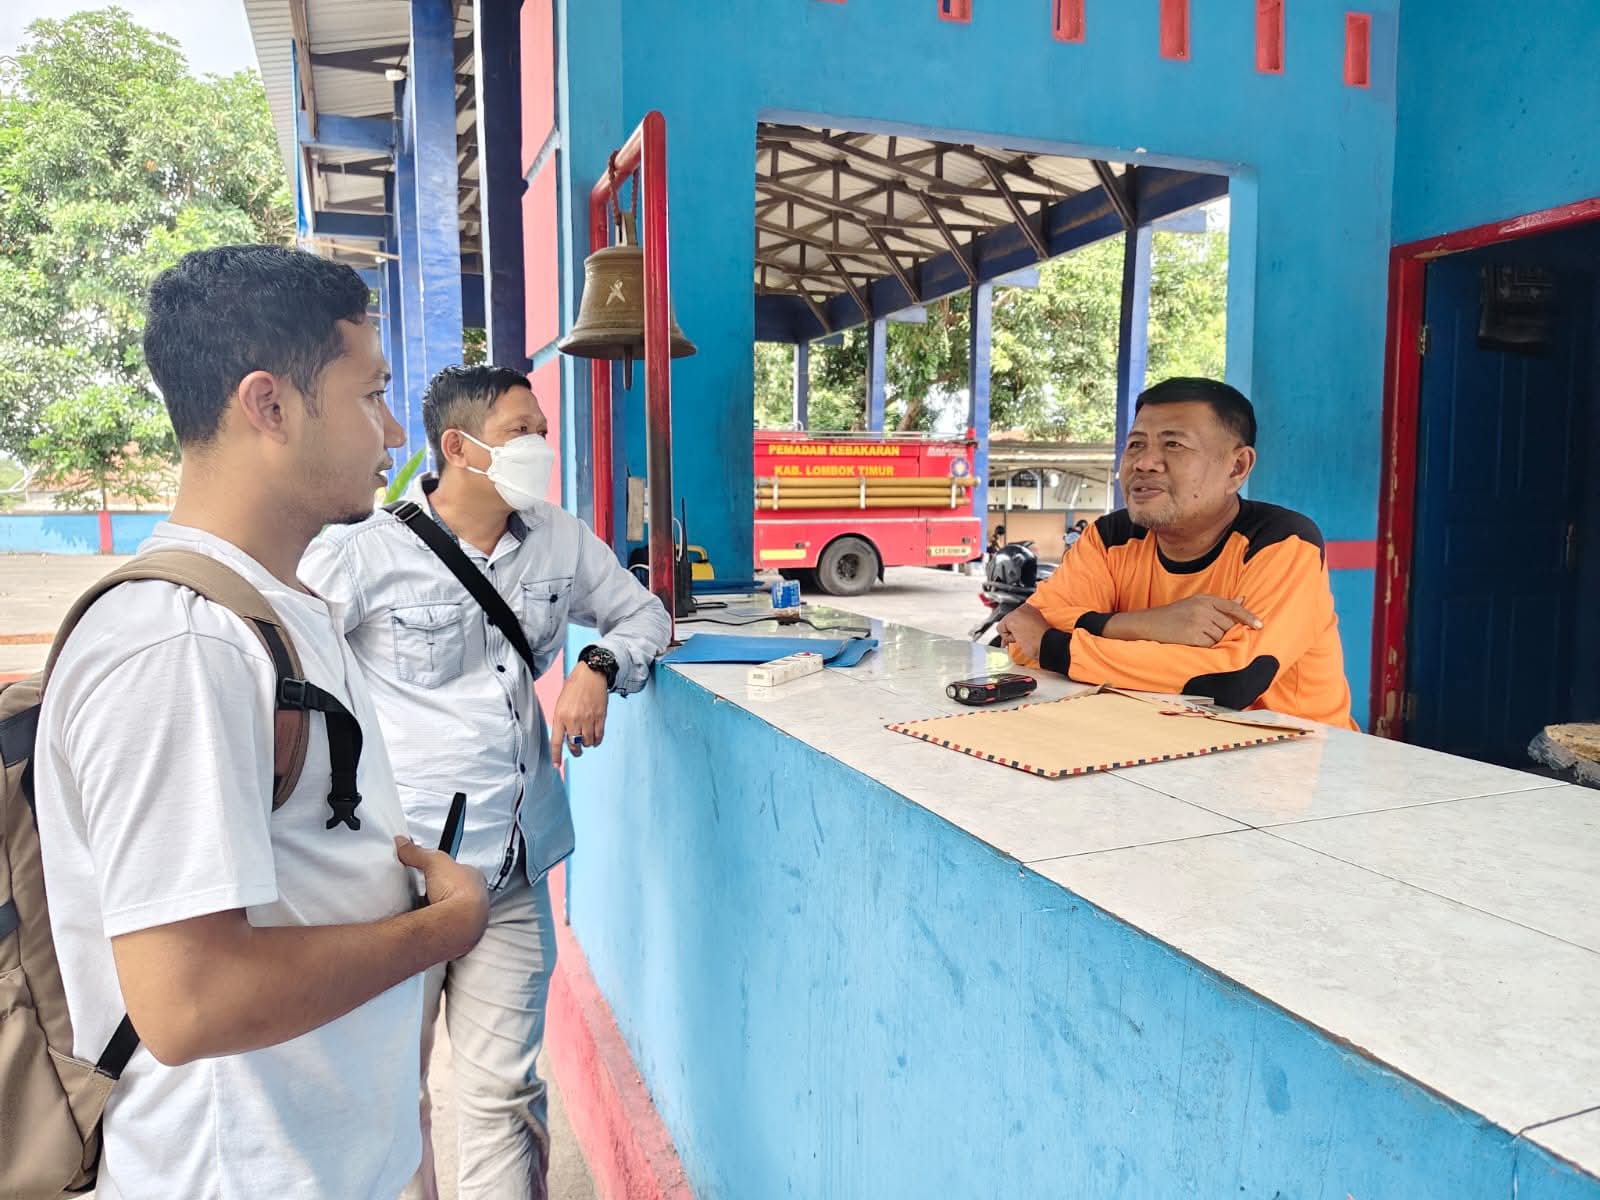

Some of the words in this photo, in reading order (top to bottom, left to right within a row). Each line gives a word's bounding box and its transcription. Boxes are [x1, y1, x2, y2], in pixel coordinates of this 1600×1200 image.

[768, 445, 827, 456] PEMADAM
[829, 445, 900, 457] KEBAKARAN
[774, 465, 803, 477] KAB.
[806, 465, 856, 477] LOMBOK
[858, 465, 894, 477] TIMUR
